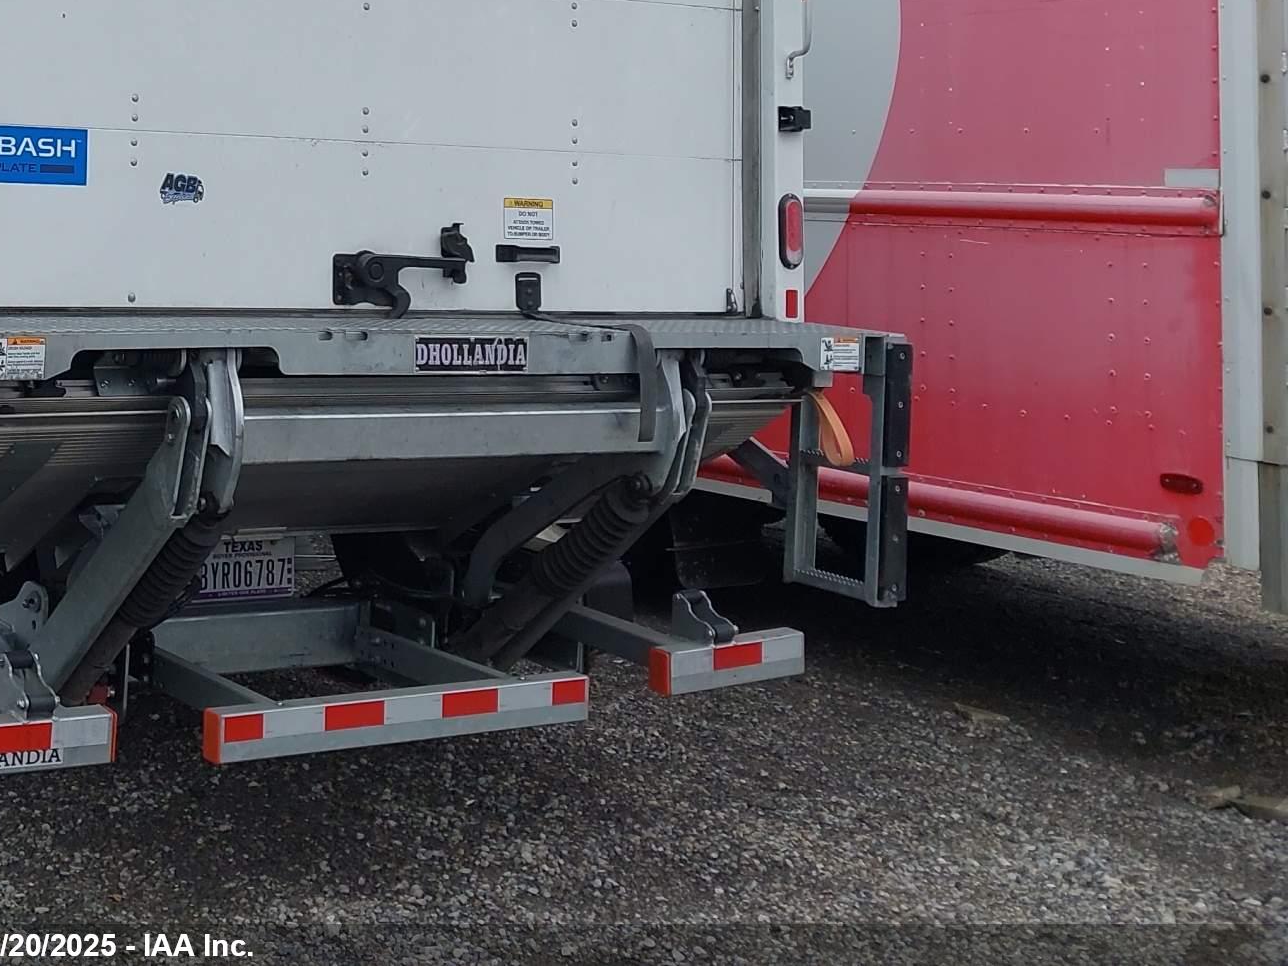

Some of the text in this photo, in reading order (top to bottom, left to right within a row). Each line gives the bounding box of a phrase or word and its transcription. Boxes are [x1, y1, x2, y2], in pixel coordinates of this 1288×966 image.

[162, 172, 198, 193] AGB
[416, 343, 526, 366] DHOLLANDIA
[223, 540, 263, 553] TEXAS
